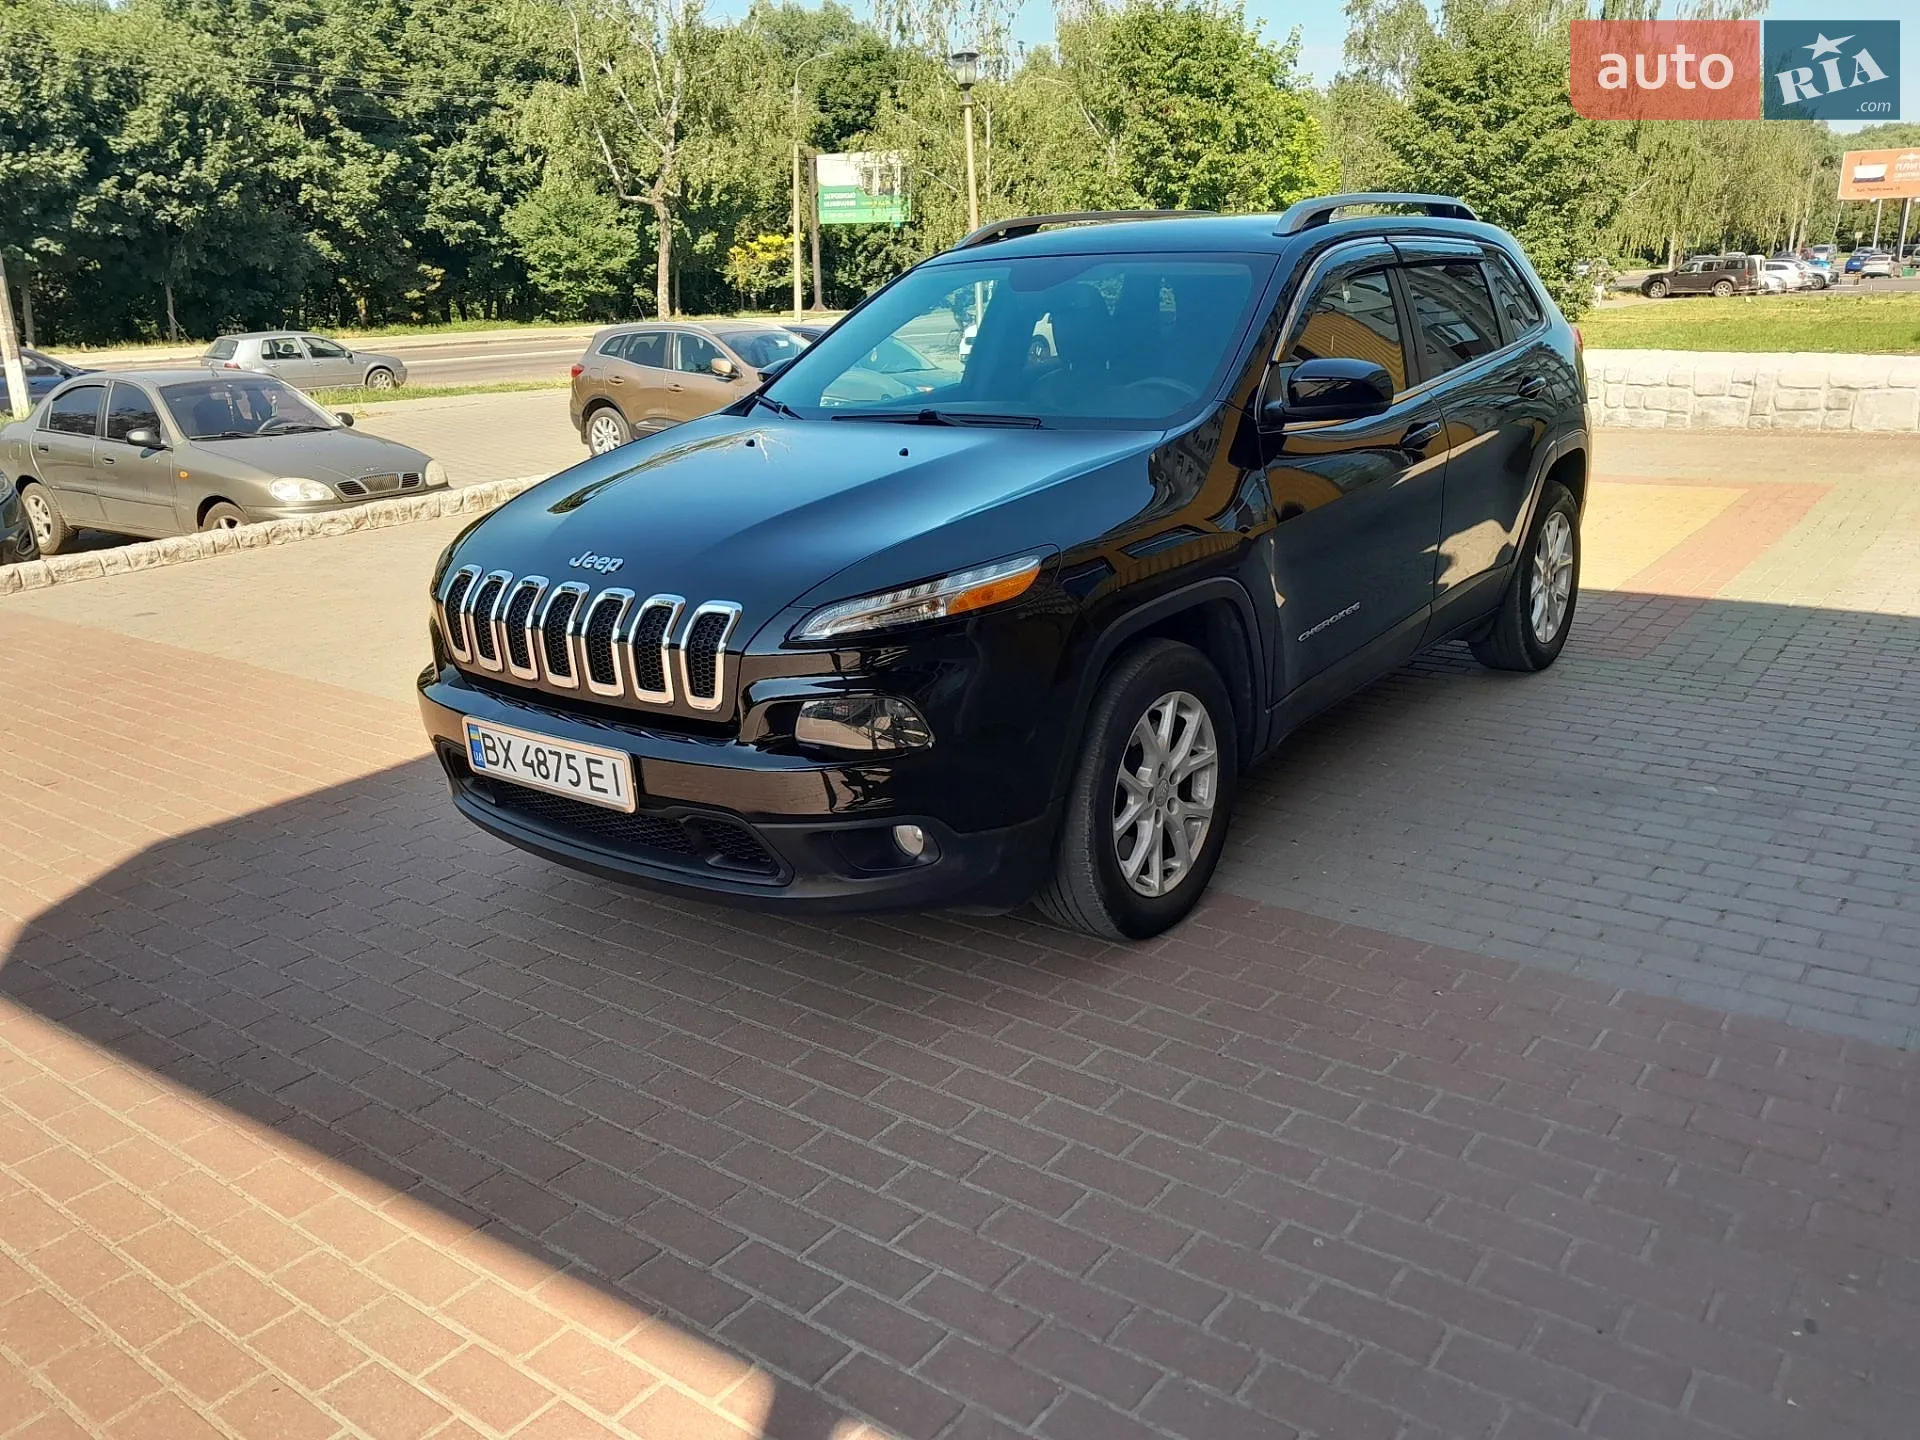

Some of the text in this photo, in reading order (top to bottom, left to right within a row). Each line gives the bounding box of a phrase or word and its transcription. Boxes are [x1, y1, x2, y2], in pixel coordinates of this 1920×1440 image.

[568, 551, 624, 575] Jeep
[1298, 602, 1361, 641] CHEROKEE
[482, 732, 621, 796] BX 4875 EI
